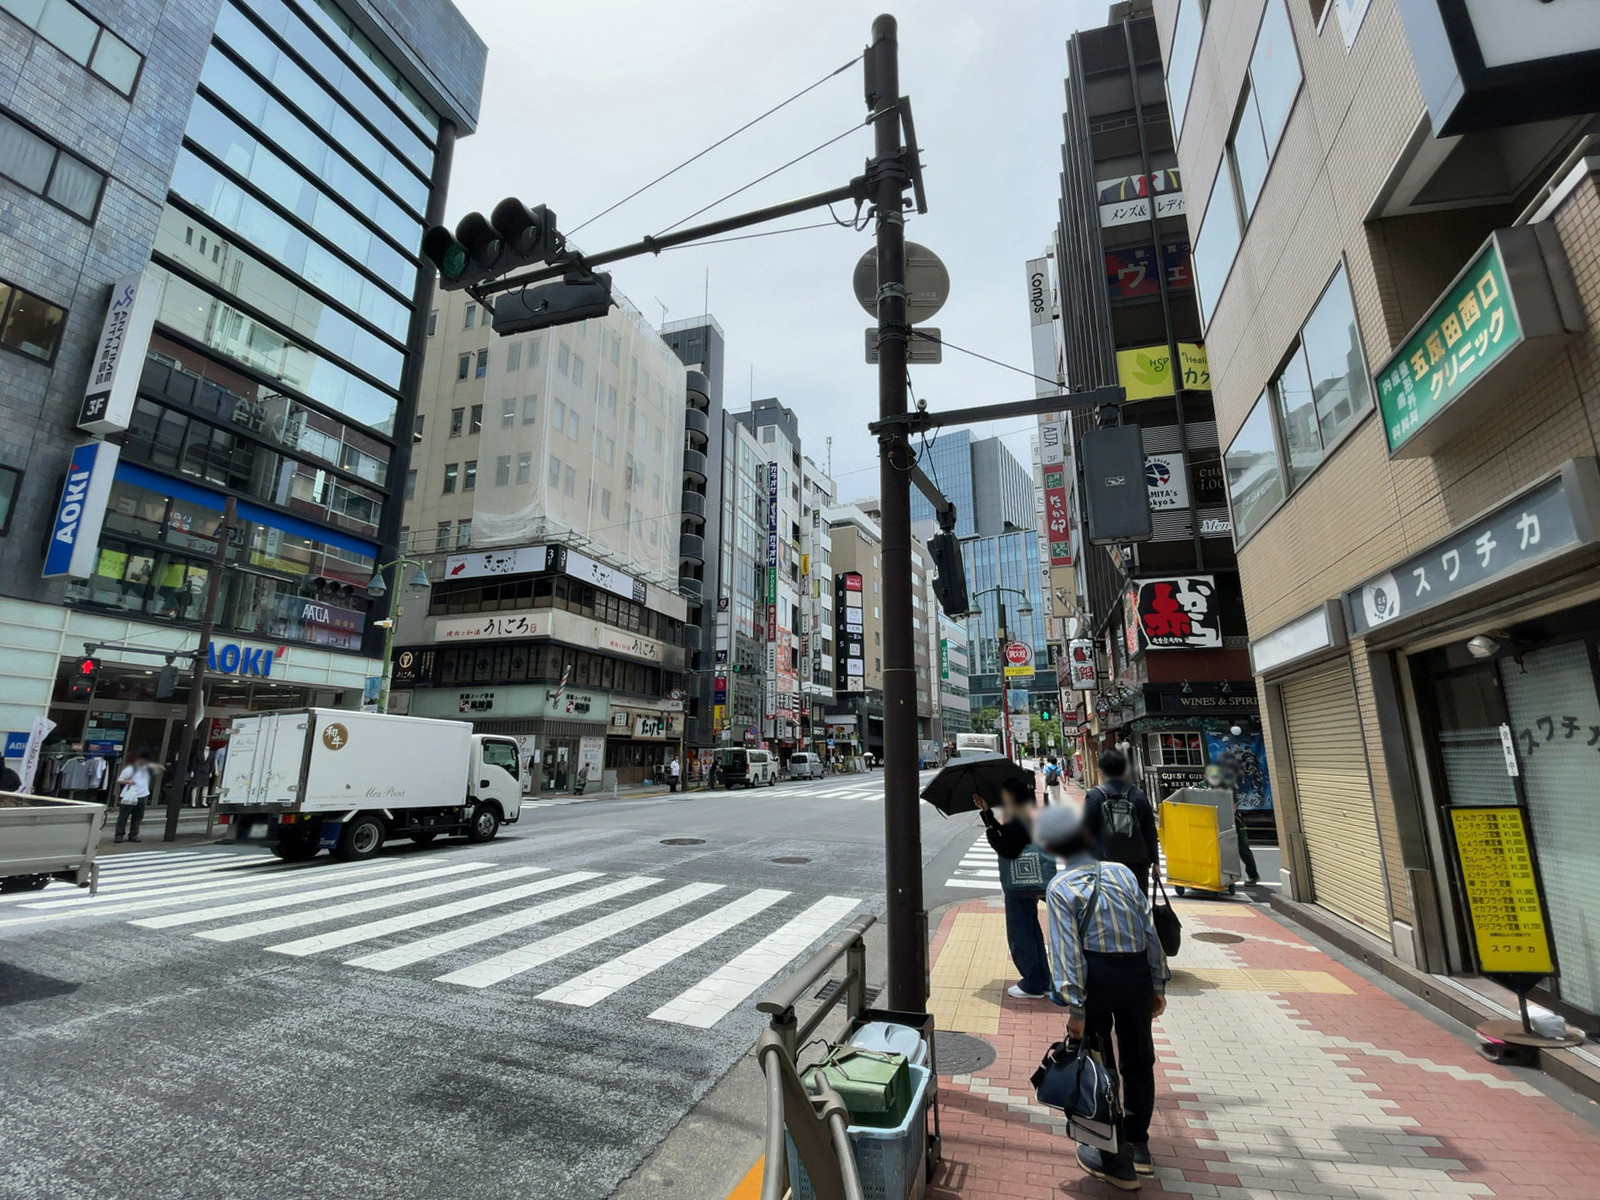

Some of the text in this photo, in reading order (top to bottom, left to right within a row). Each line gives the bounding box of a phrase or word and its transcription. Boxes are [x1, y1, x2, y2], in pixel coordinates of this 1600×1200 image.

[1031, 272, 1045, 314] Comps
[95, 311, 121, 385] FITNESS
[103, 311, 128, 383] ANYTIME
[1411, 270, 1499, 381] 五反田西口
[1430, 306, 1504, 401] クリニック
[86, 397, 105, 416] 3F
[56, 470, 90, 544] AOKI
[1149, 490, 1178, 498] MIYA's
[1412, 512, 1541, 597] スワチカ
[1181, 696, 1260, 706] WINES & SPIRI
[325, 726, 344, 749] 和牛
[1491, 945, 1536, 953] スワチカ
